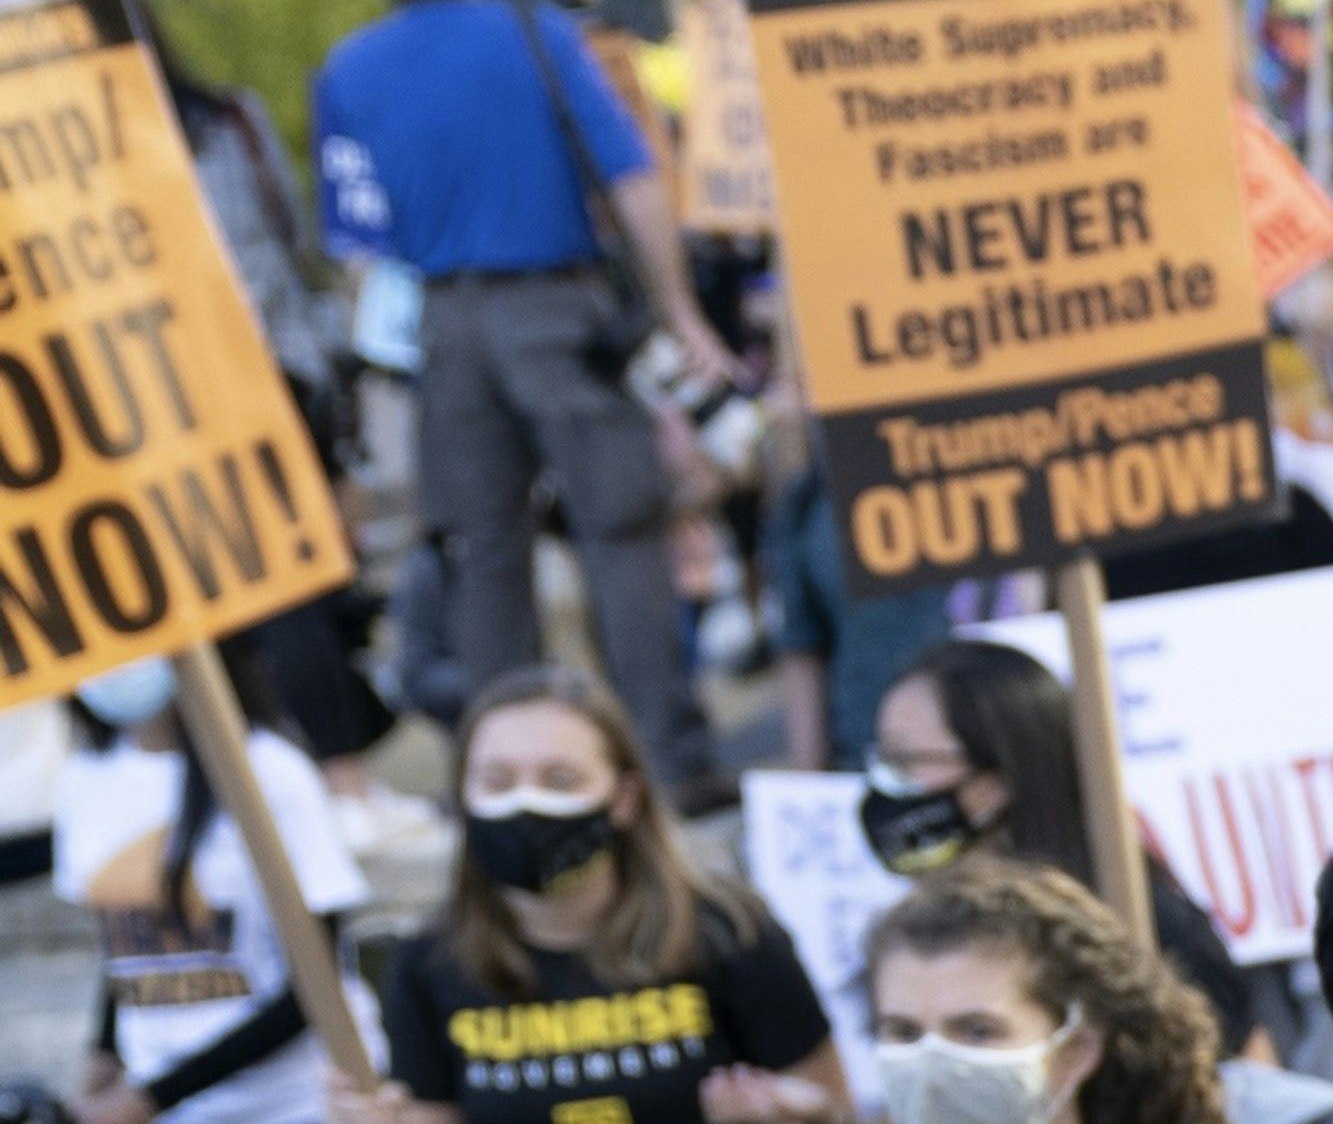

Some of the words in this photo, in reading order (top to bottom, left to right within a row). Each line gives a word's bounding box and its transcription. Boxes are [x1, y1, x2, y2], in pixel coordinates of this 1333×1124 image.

[785, 28, 923, 77] White
[838, 70, 1074, 130] Theocracy
[1093, 47, 1167, 95] and
[876, 130, 1067, 182] Fascism
[1085, 116, 1147, 154] are
[902, 177, 1154, 280] NEVER
[850, 258, 1219, 370] Legitimate
[878, 374, 1226, 477] Trump/Pence
[852, 464, 1029, 577] OUT
[1046, 416, 1266, 544] NOW!
[447, 982, 712, 1061] SUNRISE
